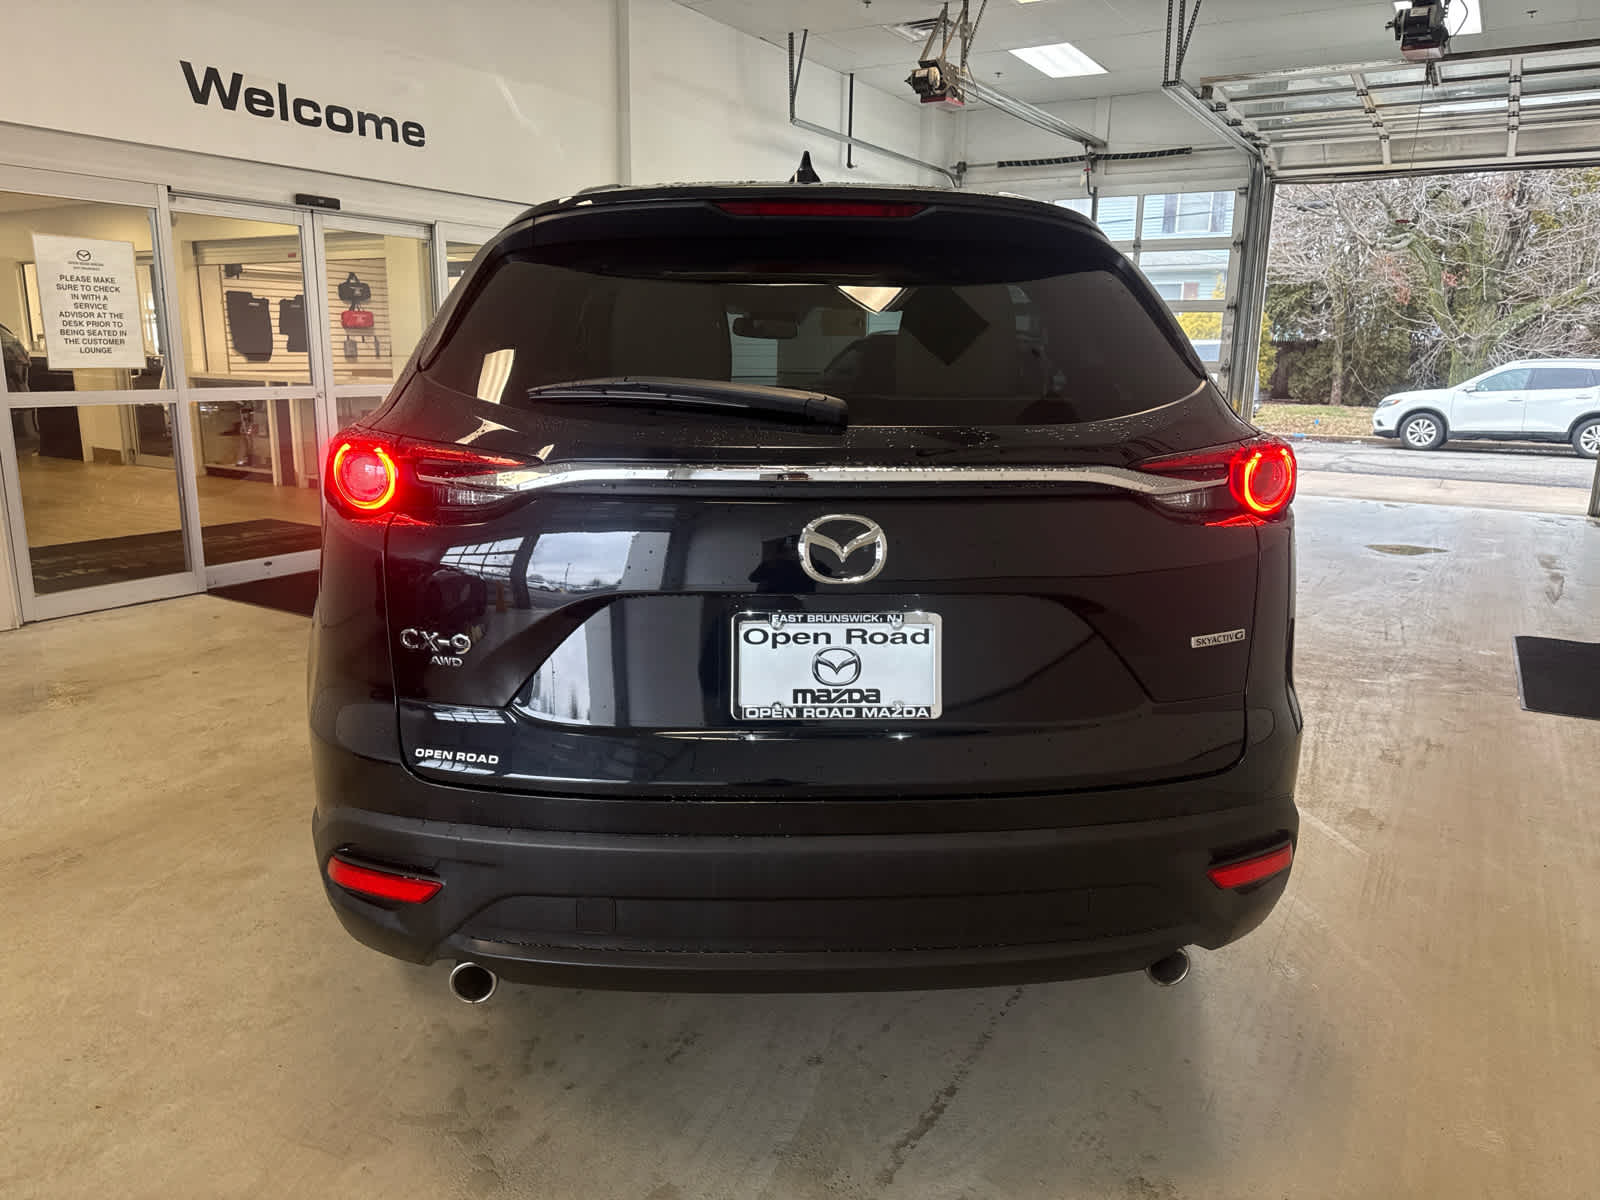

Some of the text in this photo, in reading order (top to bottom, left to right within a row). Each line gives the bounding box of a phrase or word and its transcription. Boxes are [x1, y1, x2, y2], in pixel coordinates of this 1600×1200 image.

[179, 60, 426, 148] Welcome
[59, 274, 116, 284] PLEASE MAKE
[56, 283, 120, 293] SURE TO CHECK
[71, 293, 79, 301] IN
[59, 311, 95, 319] ADVISOR
[86, 320, 111, 328] PRIOR
[112, 320, 123, 328] TO
[87, 329, 118, 337] SEATED
[64, 337, 80, 345] THE
[79, 346, 112, 354] LOUNGE
[771, 614, 803, 624] EAST
[886, 614, 903, 624] NJ
[400, 628, 472, 655] CX-9
[743, 628, 930, 649] Open Road
[431, 655, 463, 666] AWD
[792, 688, 881, 704] mazda
[745, 707, 929, 719] OPEN ROAD MAZDA
[415, 748, 499, 764] OPEN ROAD
